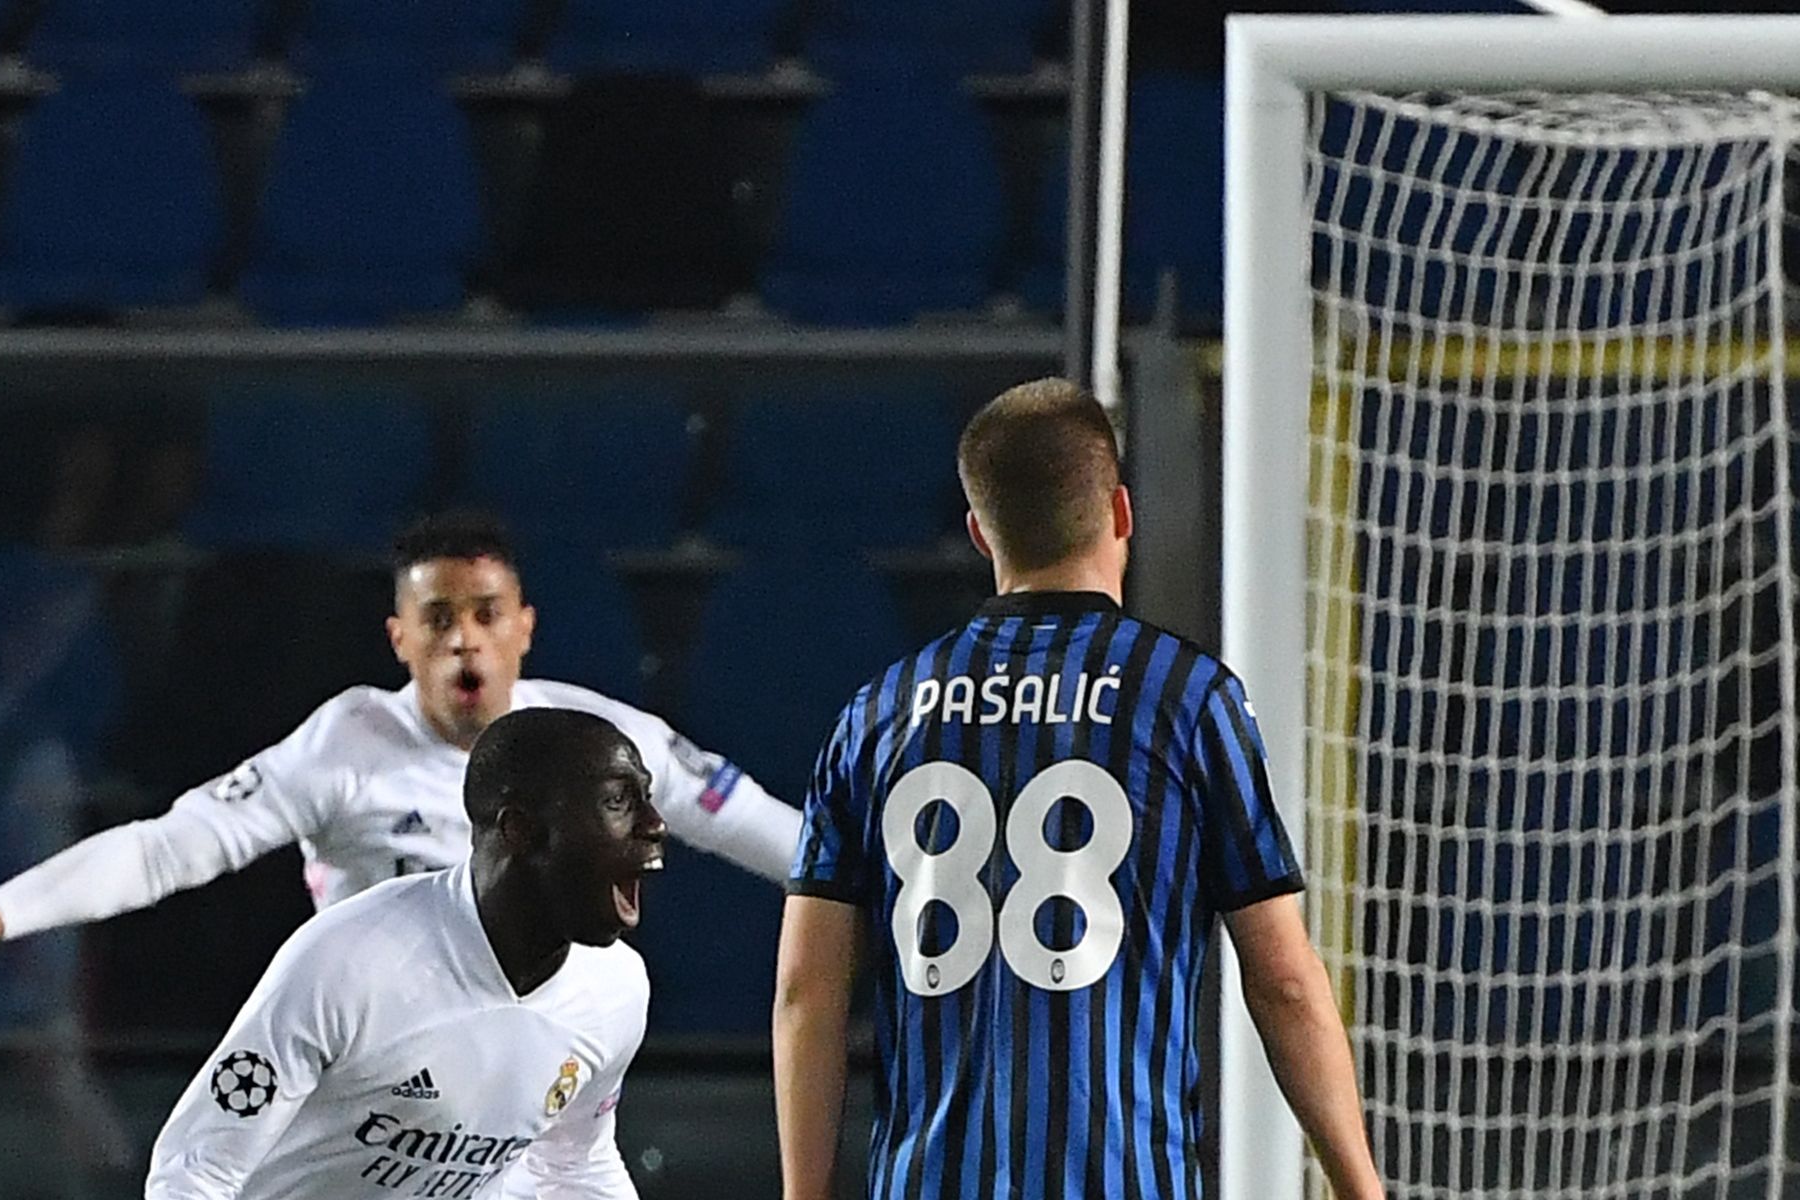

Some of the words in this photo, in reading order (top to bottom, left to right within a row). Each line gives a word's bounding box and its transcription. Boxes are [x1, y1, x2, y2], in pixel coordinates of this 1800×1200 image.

[911, 663, 1121, 727] PAŠALIĆ
[881, 758, 1134, 997] 88
[354, 1110, 533, 1167] Emirate
[360, 1155, 421, 1189] FLY
